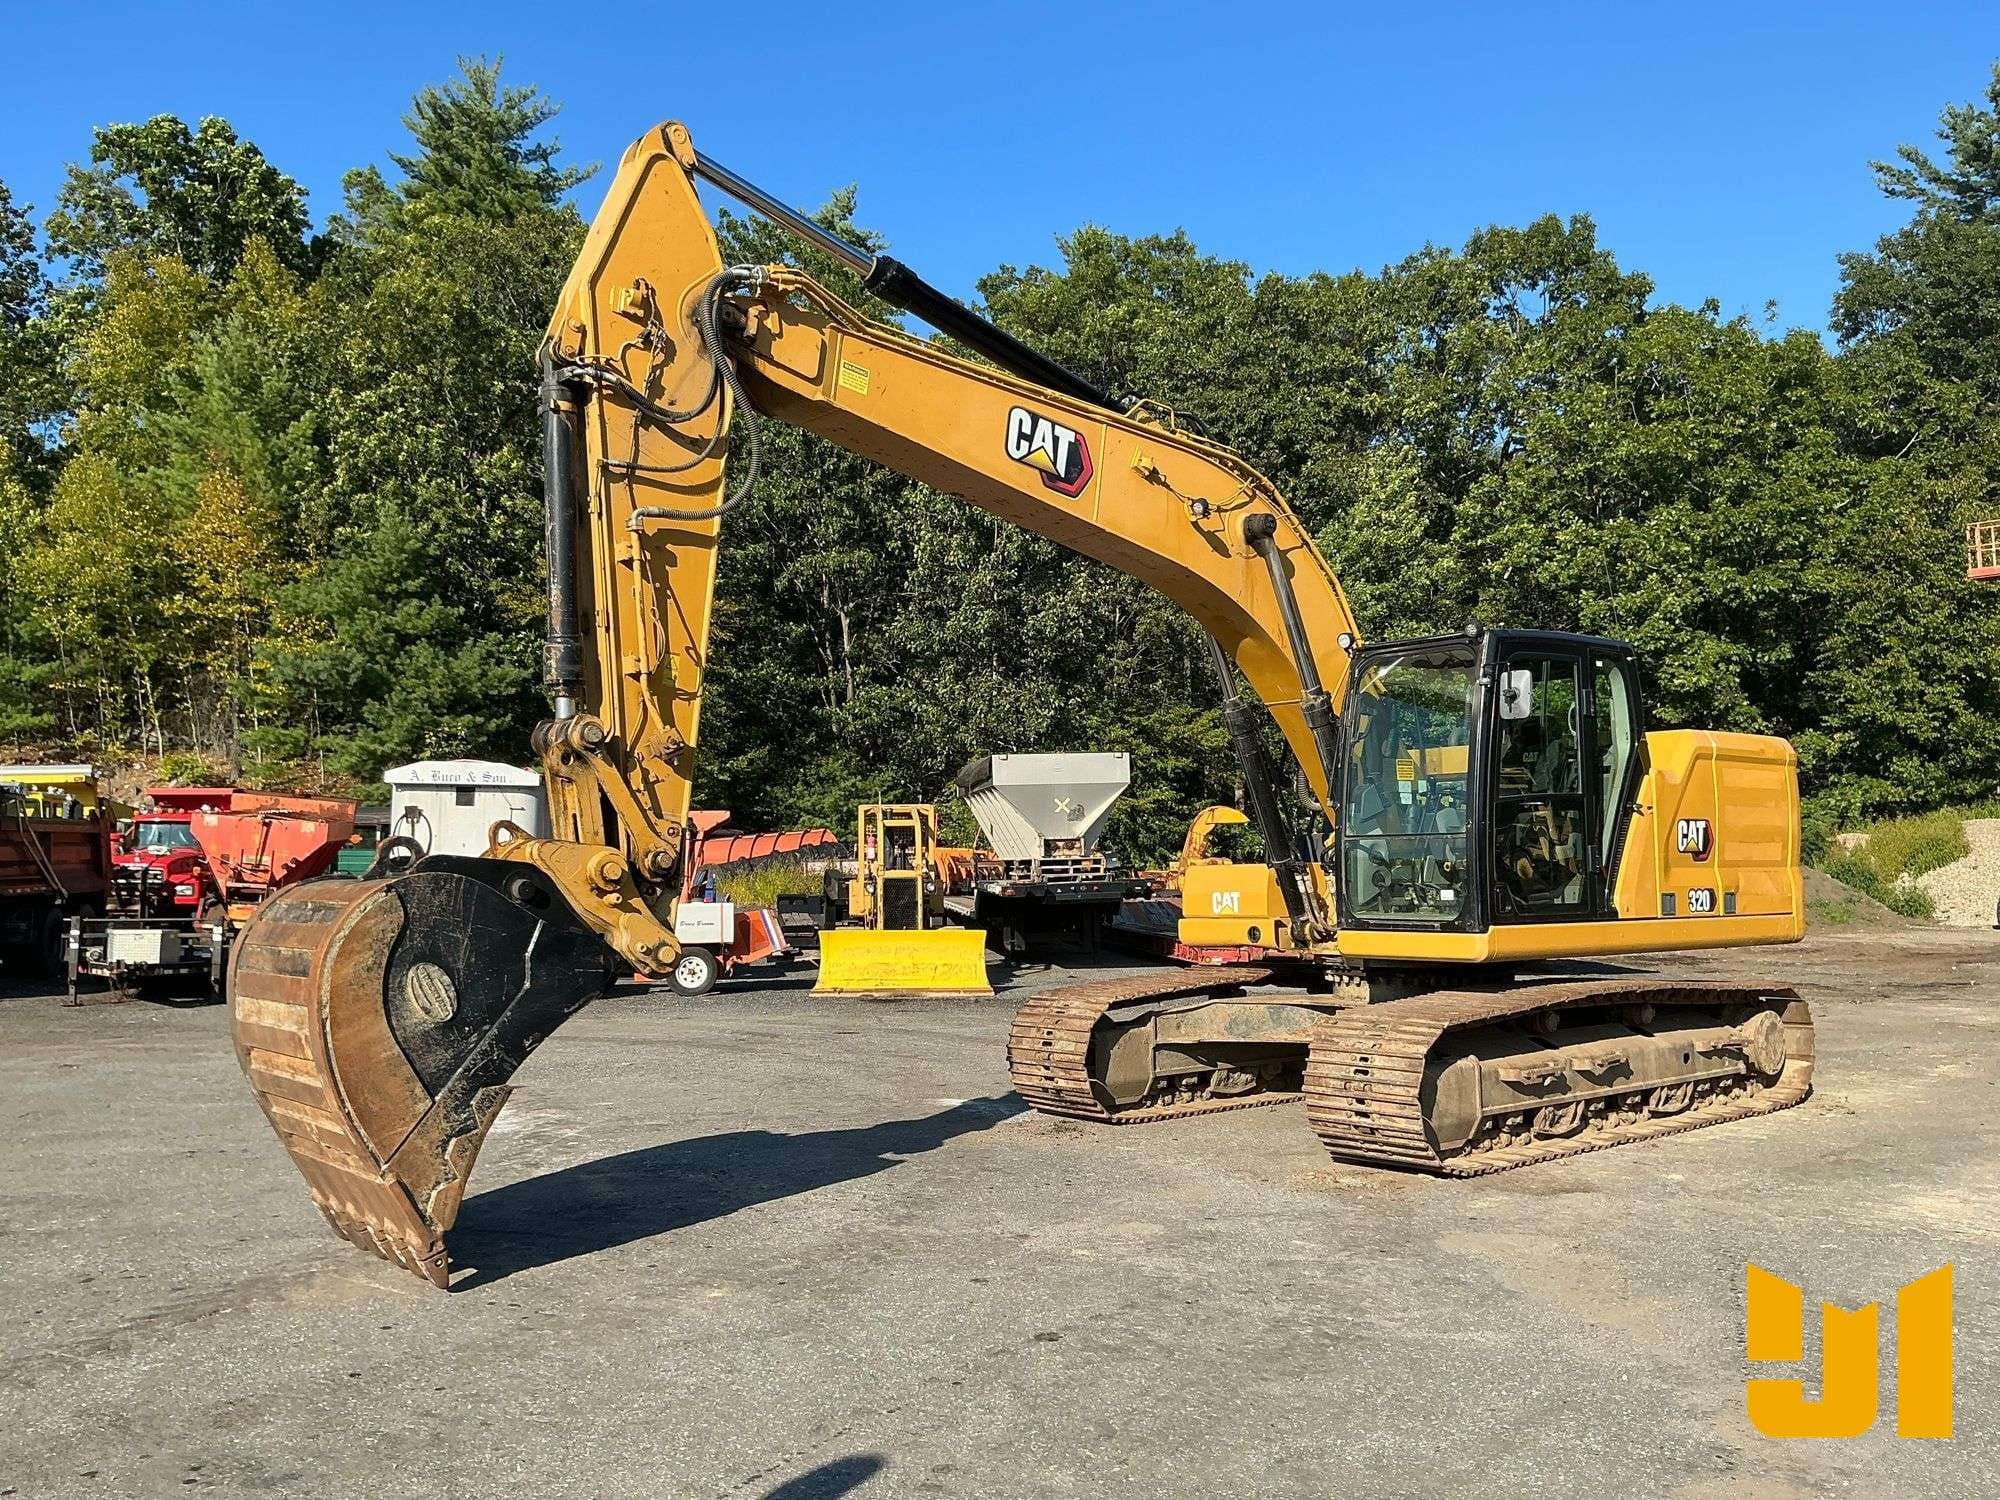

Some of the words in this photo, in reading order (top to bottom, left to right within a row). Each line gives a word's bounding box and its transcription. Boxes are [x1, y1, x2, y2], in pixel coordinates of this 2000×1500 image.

[1007, 407, 1076, 478] CAT
[1523, 752, 1539, 762] CAT
[1678, 820, 1706, 852] CAT
[1212, 891, 1240, 914] CAT
[1689, 890, 1710, 912] 320
